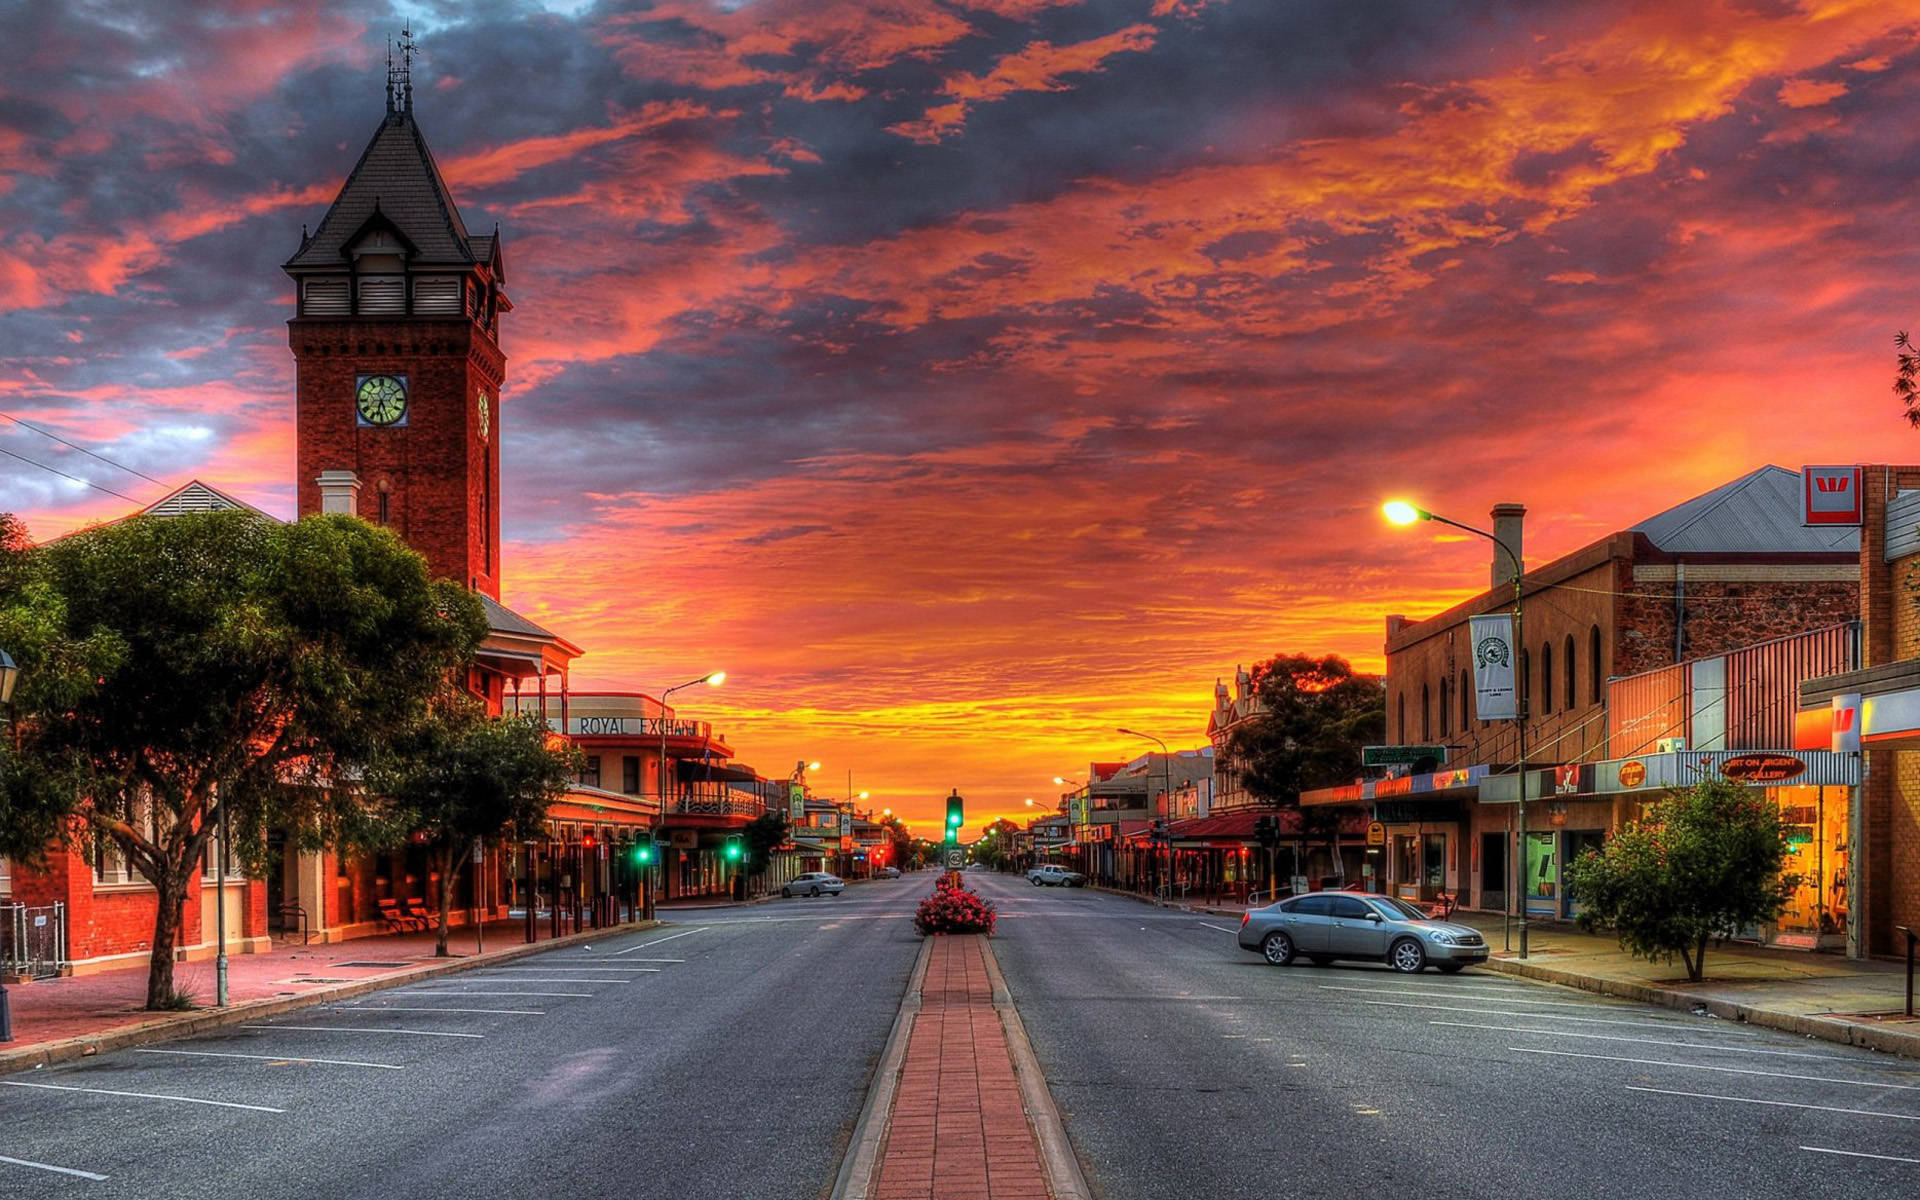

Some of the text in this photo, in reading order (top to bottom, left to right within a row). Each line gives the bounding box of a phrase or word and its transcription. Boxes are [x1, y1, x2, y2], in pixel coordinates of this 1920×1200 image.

[580, 718, 628, 735] ROYAL
[1745, 759, 1760, 767] ON
[1762, 758, 1796, 767] ARGENT
[1750, 771, 1786, 779] GALLERY
